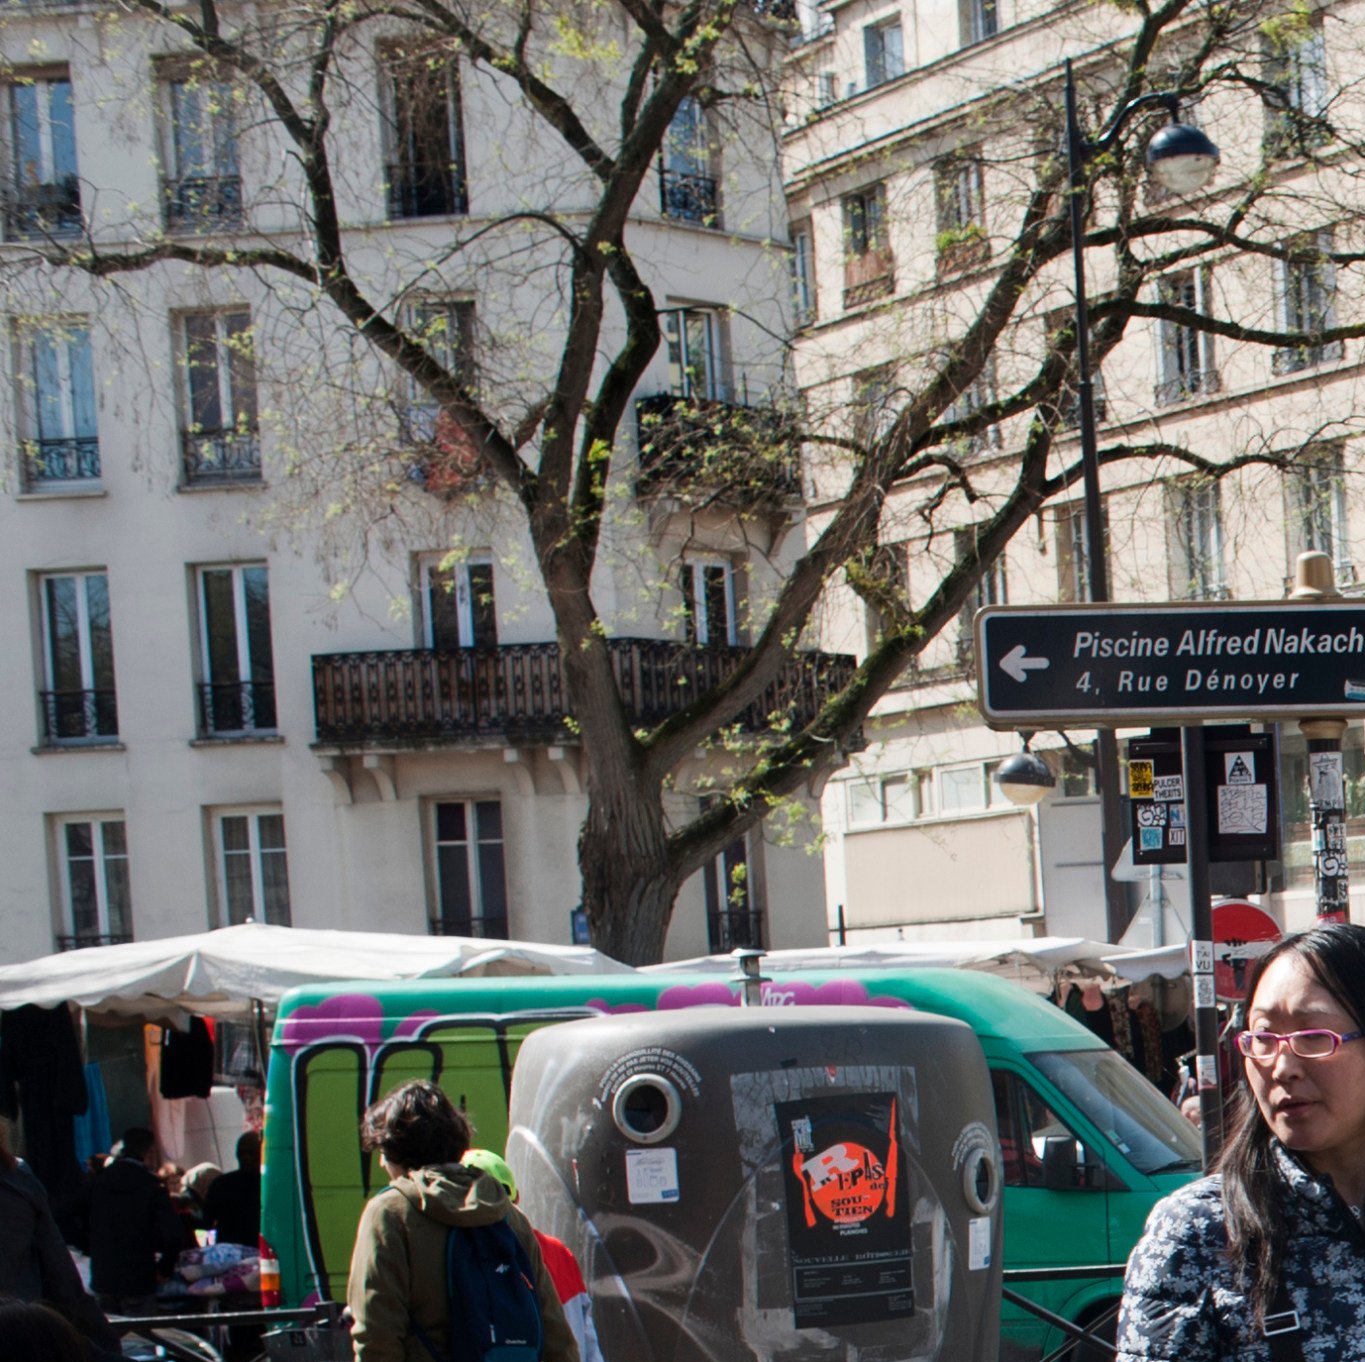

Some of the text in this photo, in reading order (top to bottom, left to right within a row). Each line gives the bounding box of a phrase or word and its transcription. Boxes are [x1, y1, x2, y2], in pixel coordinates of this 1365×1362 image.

[1073, 630, 1169, 658] Piscine
[1176, 628, 1260, 656] Alfred
[1076, 667, 1299, 694] 4, Rue Dénoyer
